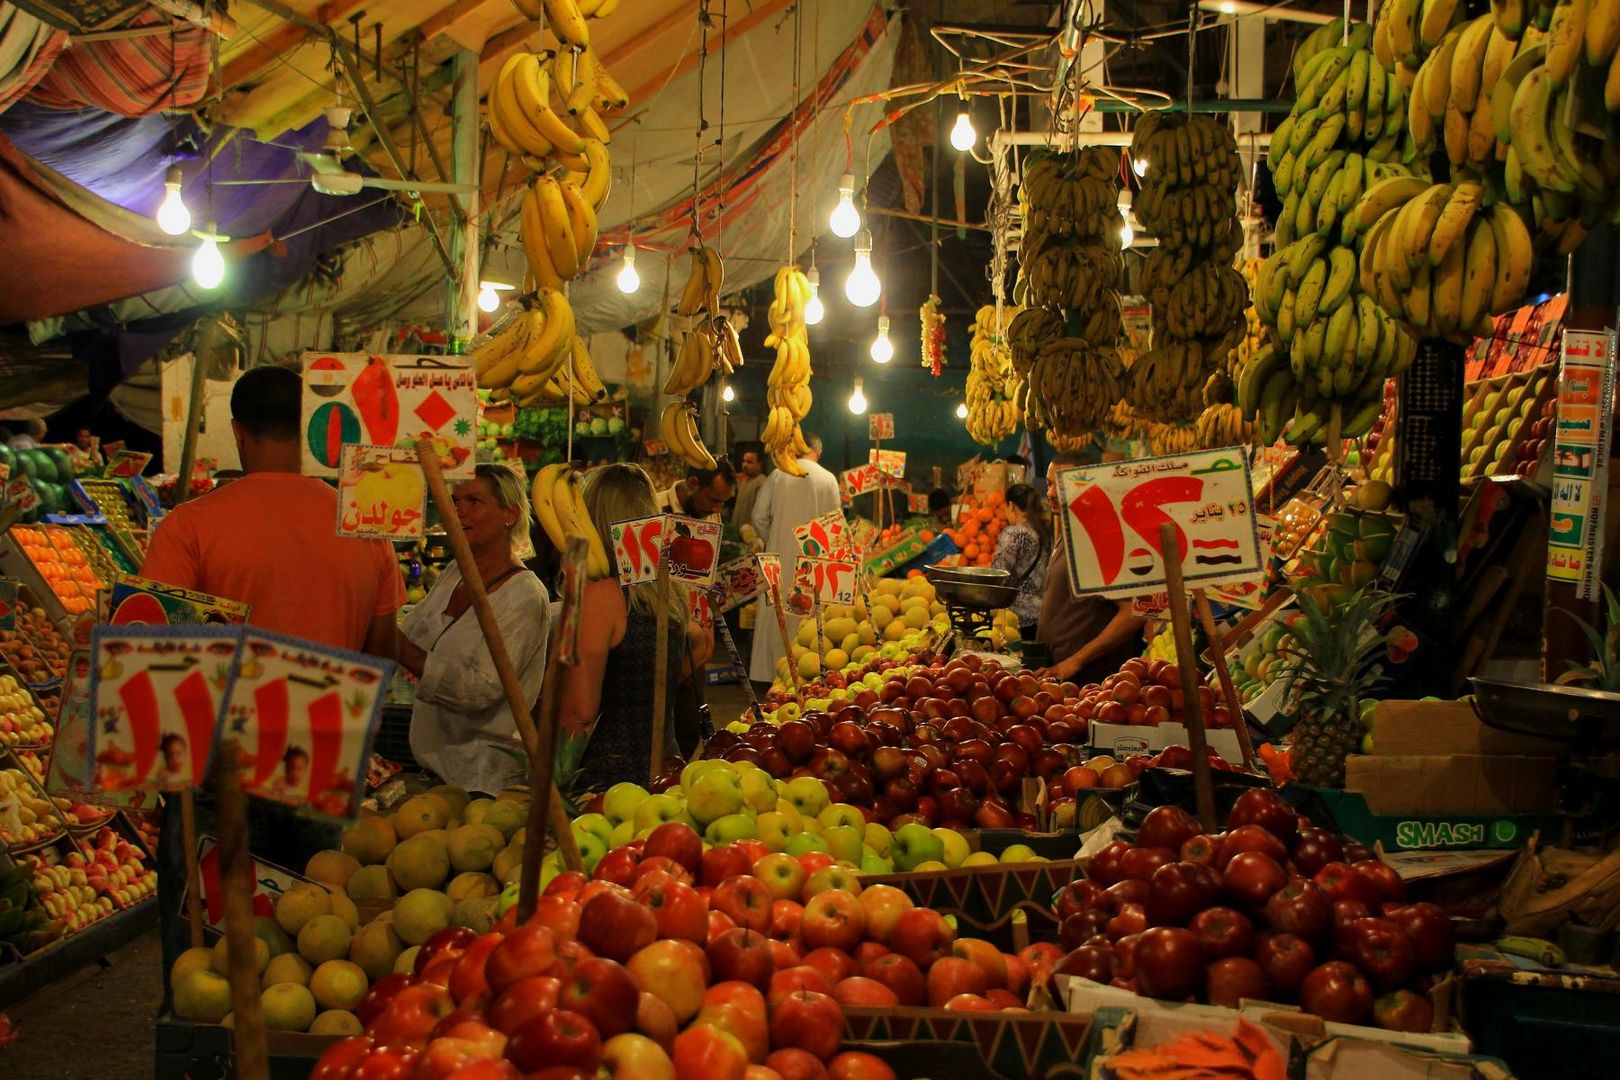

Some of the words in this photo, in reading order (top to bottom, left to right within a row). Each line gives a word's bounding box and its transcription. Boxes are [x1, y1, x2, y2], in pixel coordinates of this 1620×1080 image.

[342, 500, 422, 535] جولدن
[814, 561, 854, 600] ١٢
[837, 591, 852, 603] 12
[1396, 820, 1485, 850] SMASH
